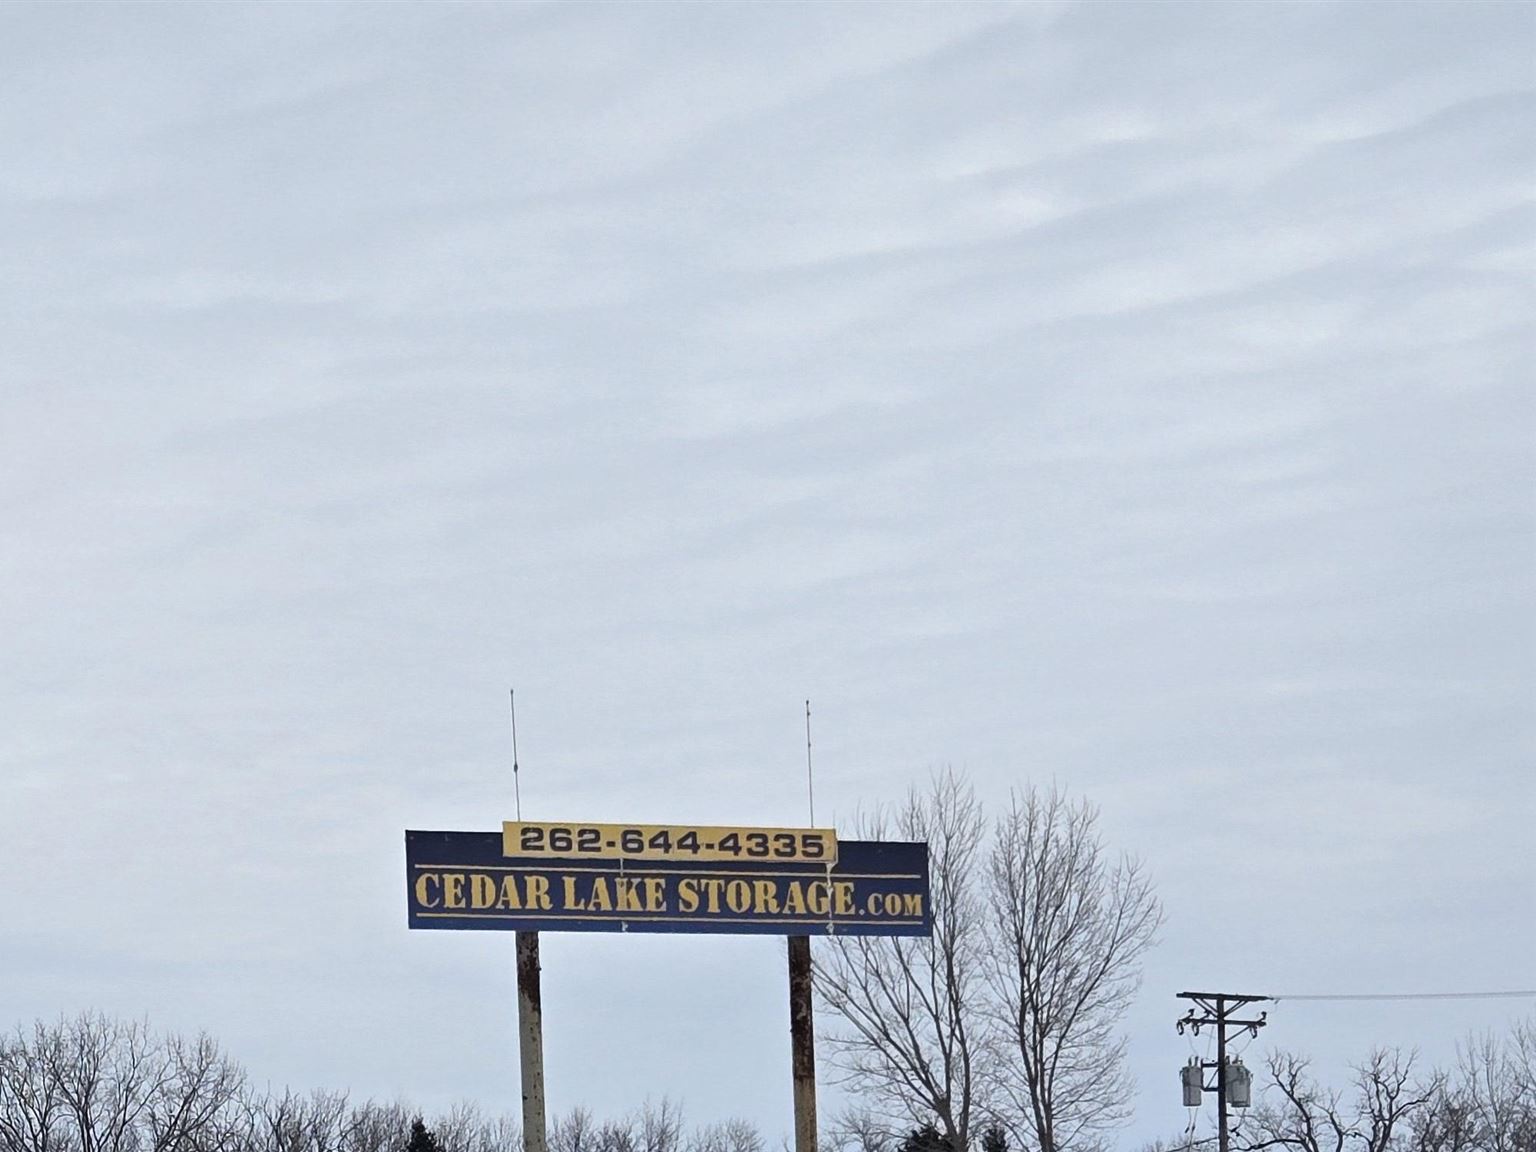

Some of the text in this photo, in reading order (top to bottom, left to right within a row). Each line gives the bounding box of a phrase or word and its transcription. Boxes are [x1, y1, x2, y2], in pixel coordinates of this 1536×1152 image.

[520, 827, 825, 858] 262-644-4335
[415, 872, 553, 910] CEDAR
[562, 875, 667, 912] LAKE
